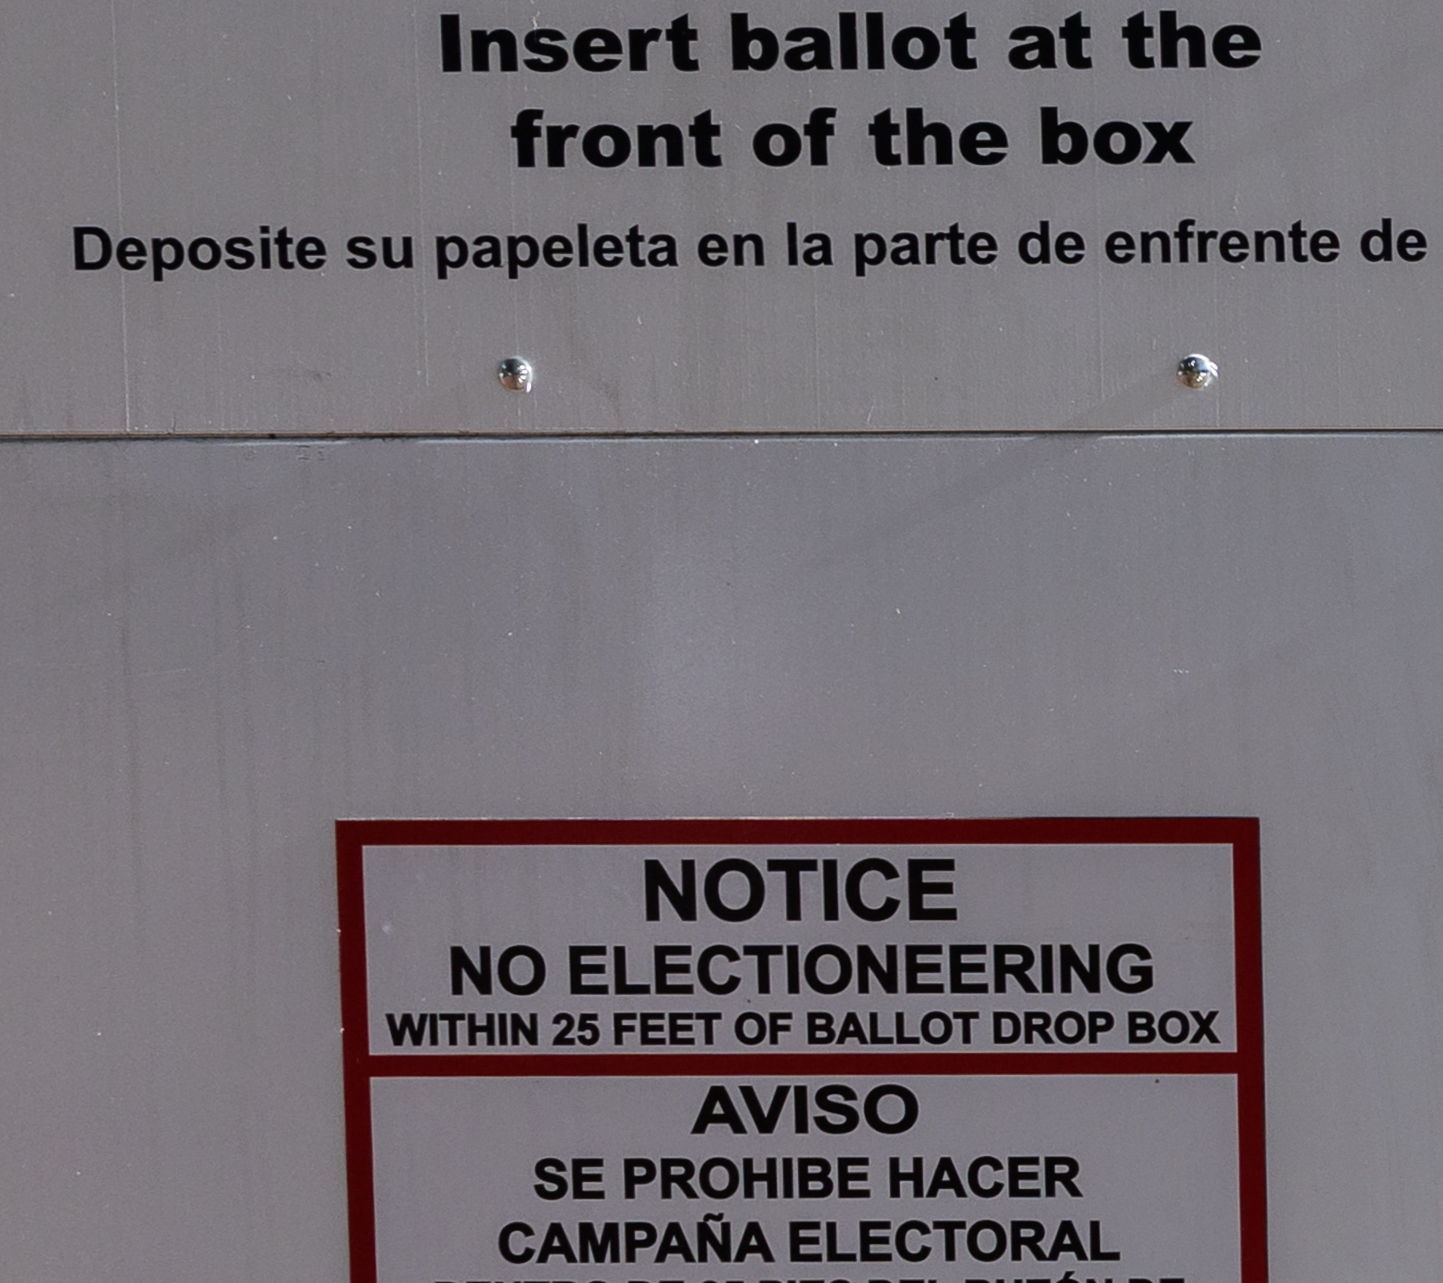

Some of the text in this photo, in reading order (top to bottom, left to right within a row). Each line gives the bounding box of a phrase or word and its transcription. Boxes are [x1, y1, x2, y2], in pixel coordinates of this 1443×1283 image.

[441, 11, 1261, 72] Insert ballot at the
[511, 107, 1195, 168] front of the box
[74, 226, 326, 281] Deposite
[347, 237, 413, 269] su
[436, 224, 678, 279] papeleta
[698, 234, 764, 267] en
[787, 222, 833, 266] la
[855, 223, 997, 276] parte
[1018, 221, 1085, 264] de
[1105, 219, 1339, 264] enfrente
[1361, 218, 1427, 262] de
[645, 858, 957, 922] NOTICE
[451, 944, 1153, 995] NO ELECTIONEERING
